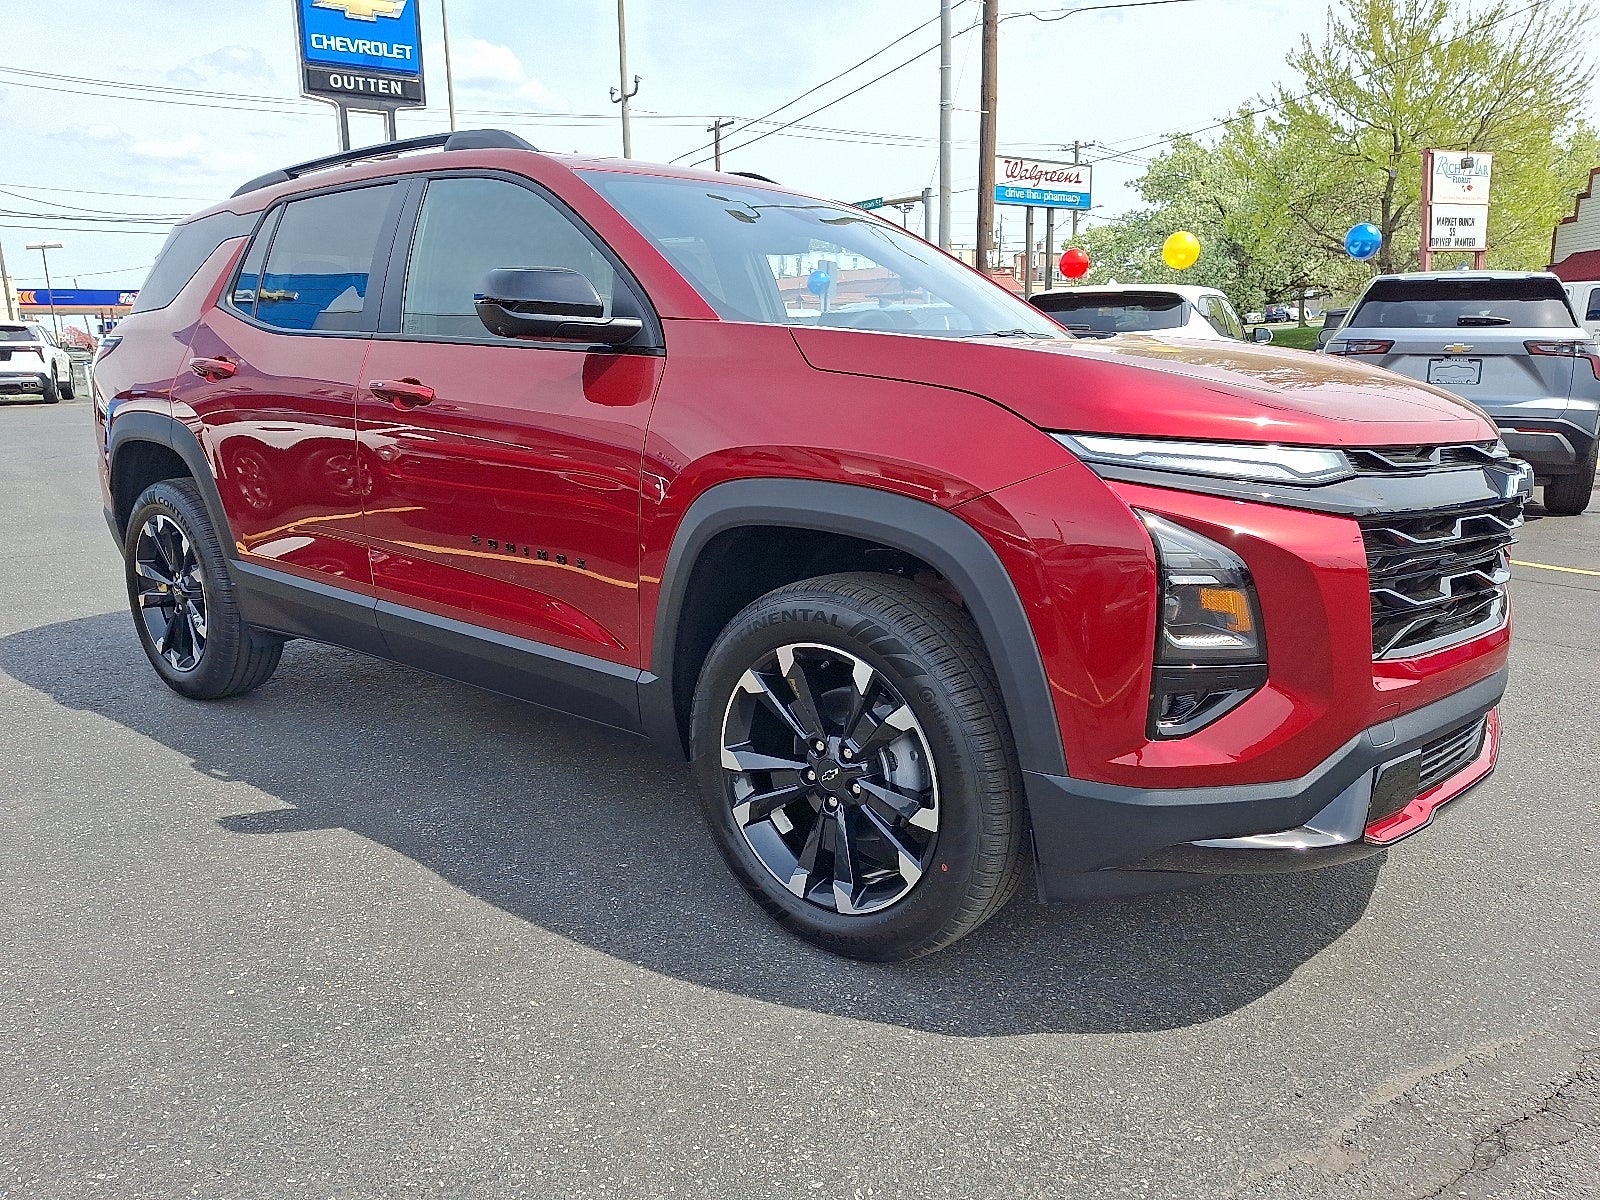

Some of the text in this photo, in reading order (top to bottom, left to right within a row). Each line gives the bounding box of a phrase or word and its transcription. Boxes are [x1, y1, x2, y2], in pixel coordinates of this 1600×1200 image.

[310, 33, 413, 60] CHEVROLET
[329, 74, 402, 95] OUTTEN
[1004, 159, 1082, 187] Walgreens
[1005, 188, 1080, 205] drive thru pharmacy
[1436, 216, 1475, 227] MARKET BUNCH
[1431, 237, 1475, 247] DRIVER WANTED
[471, 534, 586, 570] EQUINOX
